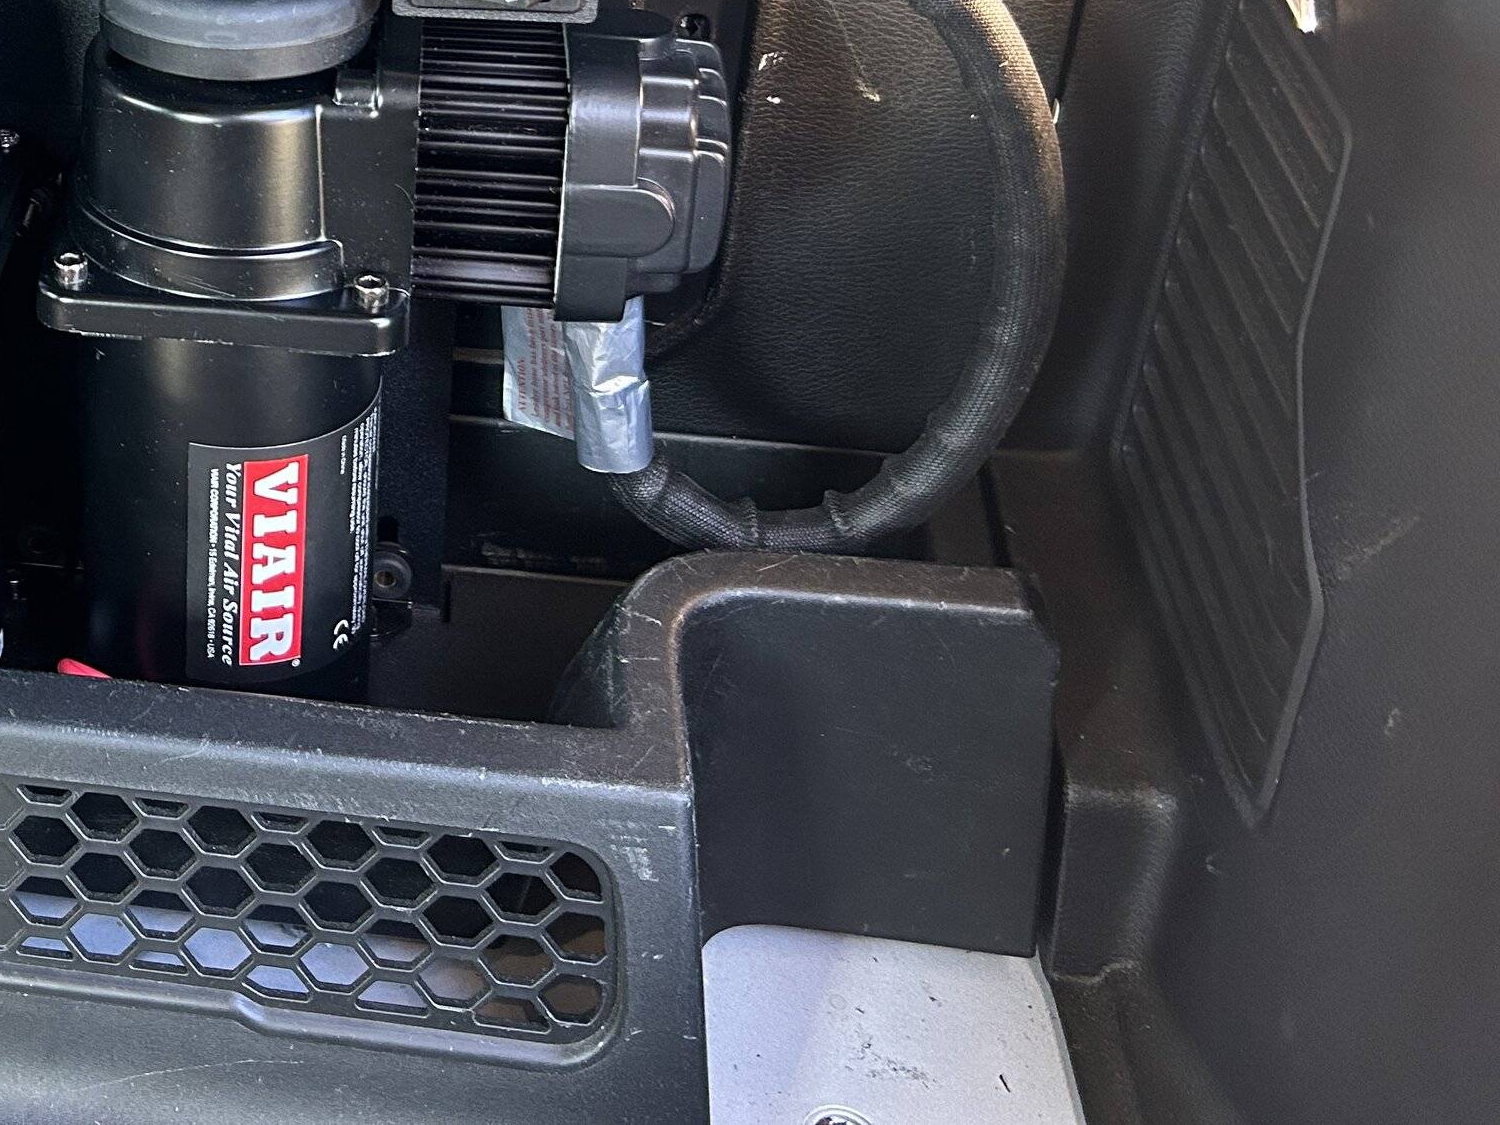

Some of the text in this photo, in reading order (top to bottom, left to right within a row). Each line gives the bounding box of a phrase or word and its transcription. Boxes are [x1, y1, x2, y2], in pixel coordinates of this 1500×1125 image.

[222, 463, 241, 666] Your Vital Air Source
[250, 461, 299, 661] VIAIR
